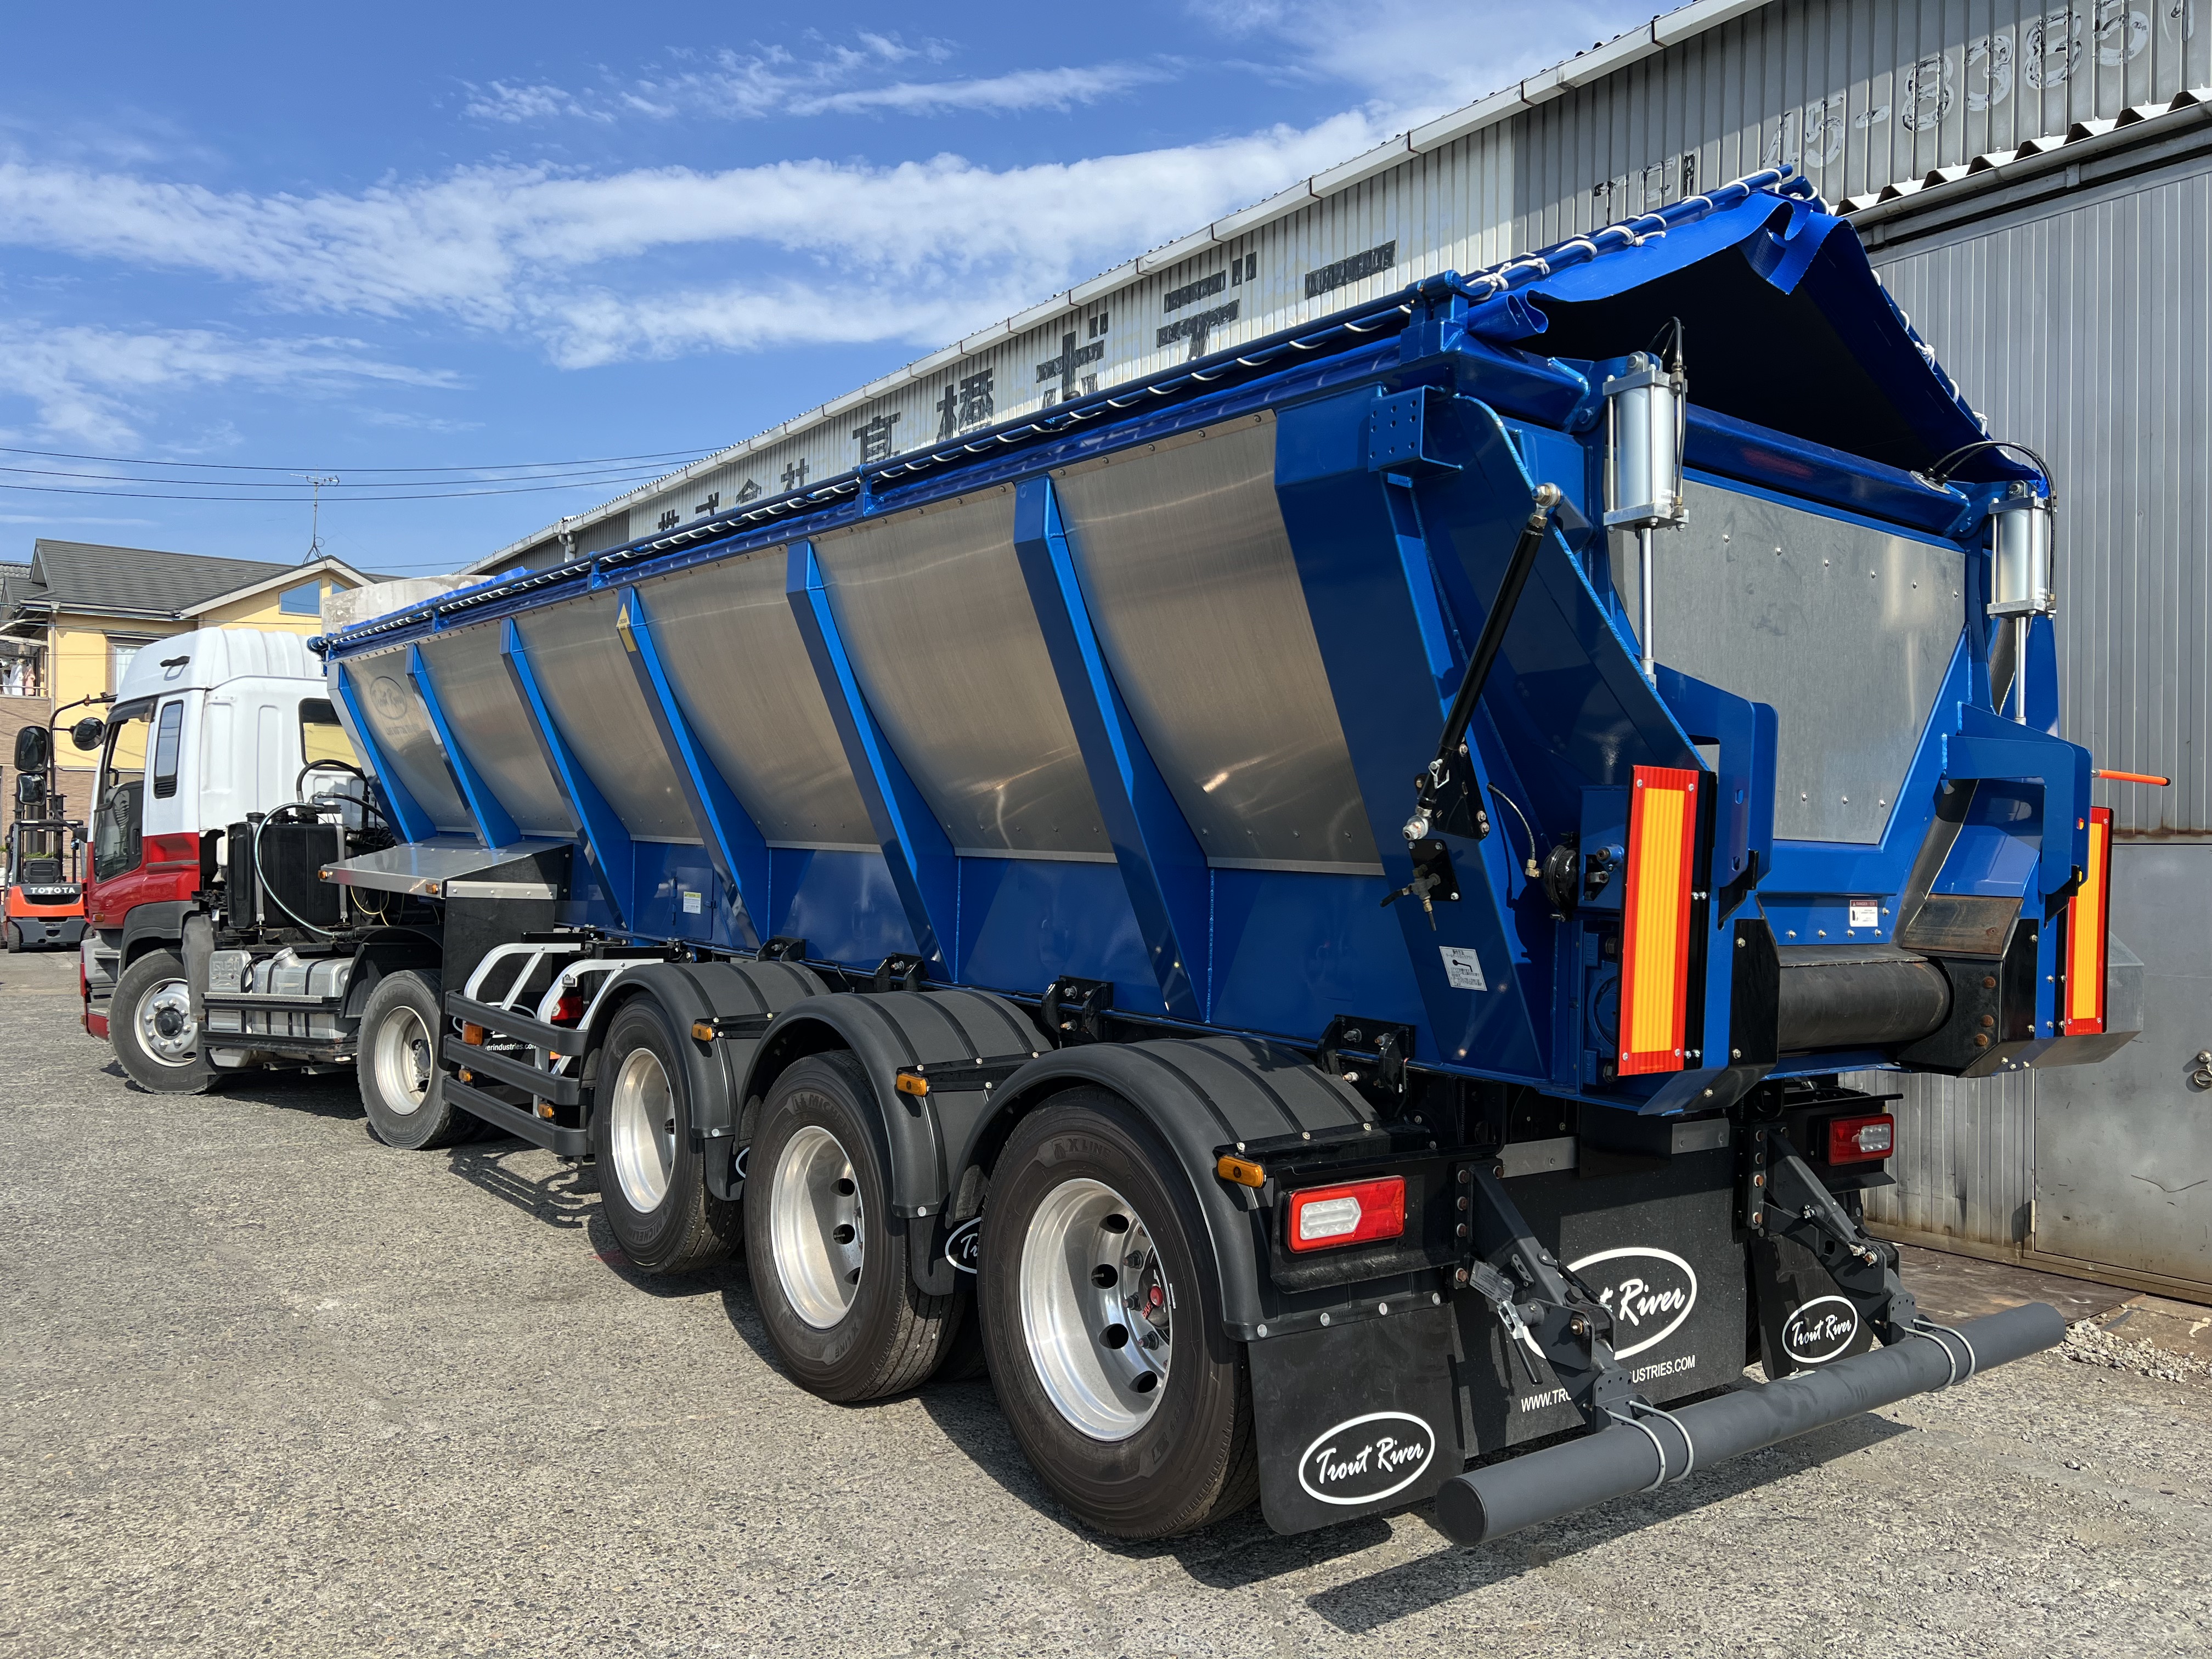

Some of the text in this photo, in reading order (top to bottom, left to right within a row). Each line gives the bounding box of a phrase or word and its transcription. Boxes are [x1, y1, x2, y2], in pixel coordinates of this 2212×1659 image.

[1619, 1278, 1685, 1327] River
[1792, 1314, 1852, 1347] Trout River
[1316, 1437, 1425, 1485] Trout River
